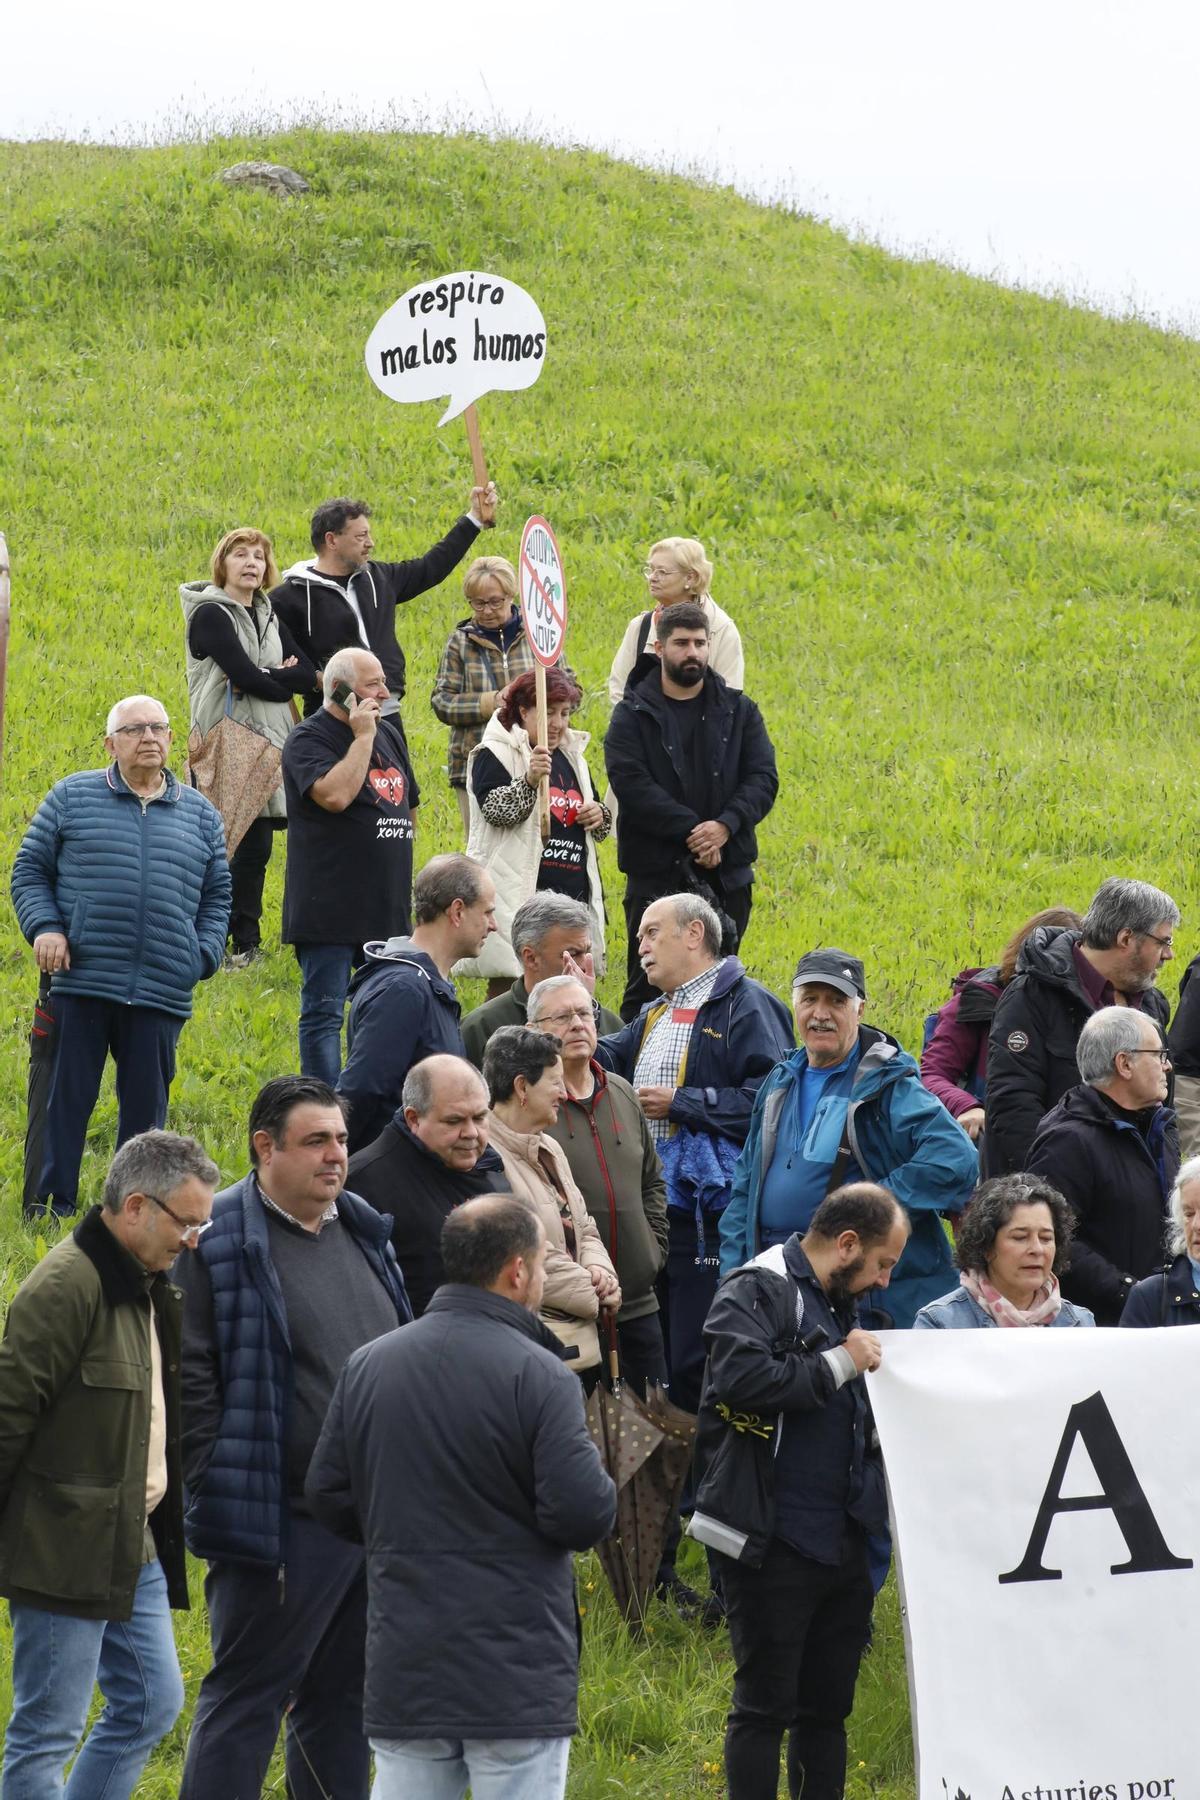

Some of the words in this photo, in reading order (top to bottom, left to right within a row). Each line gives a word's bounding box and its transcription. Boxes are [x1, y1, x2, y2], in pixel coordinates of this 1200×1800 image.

[380, 328, 457, 376] malos
[473, 317, 546, 361] humos
[532, 625, 557, 653] JOVE
[374, 777, 403, 788] XOVE
[549, 796, 582, 810] XOVE
[376, 827, 405, 839] XOVE
[541, 848, 569, 860] OVE
[998, 1390, 1193, 1584] A
[1127, 1778, 1175, 1800] por
